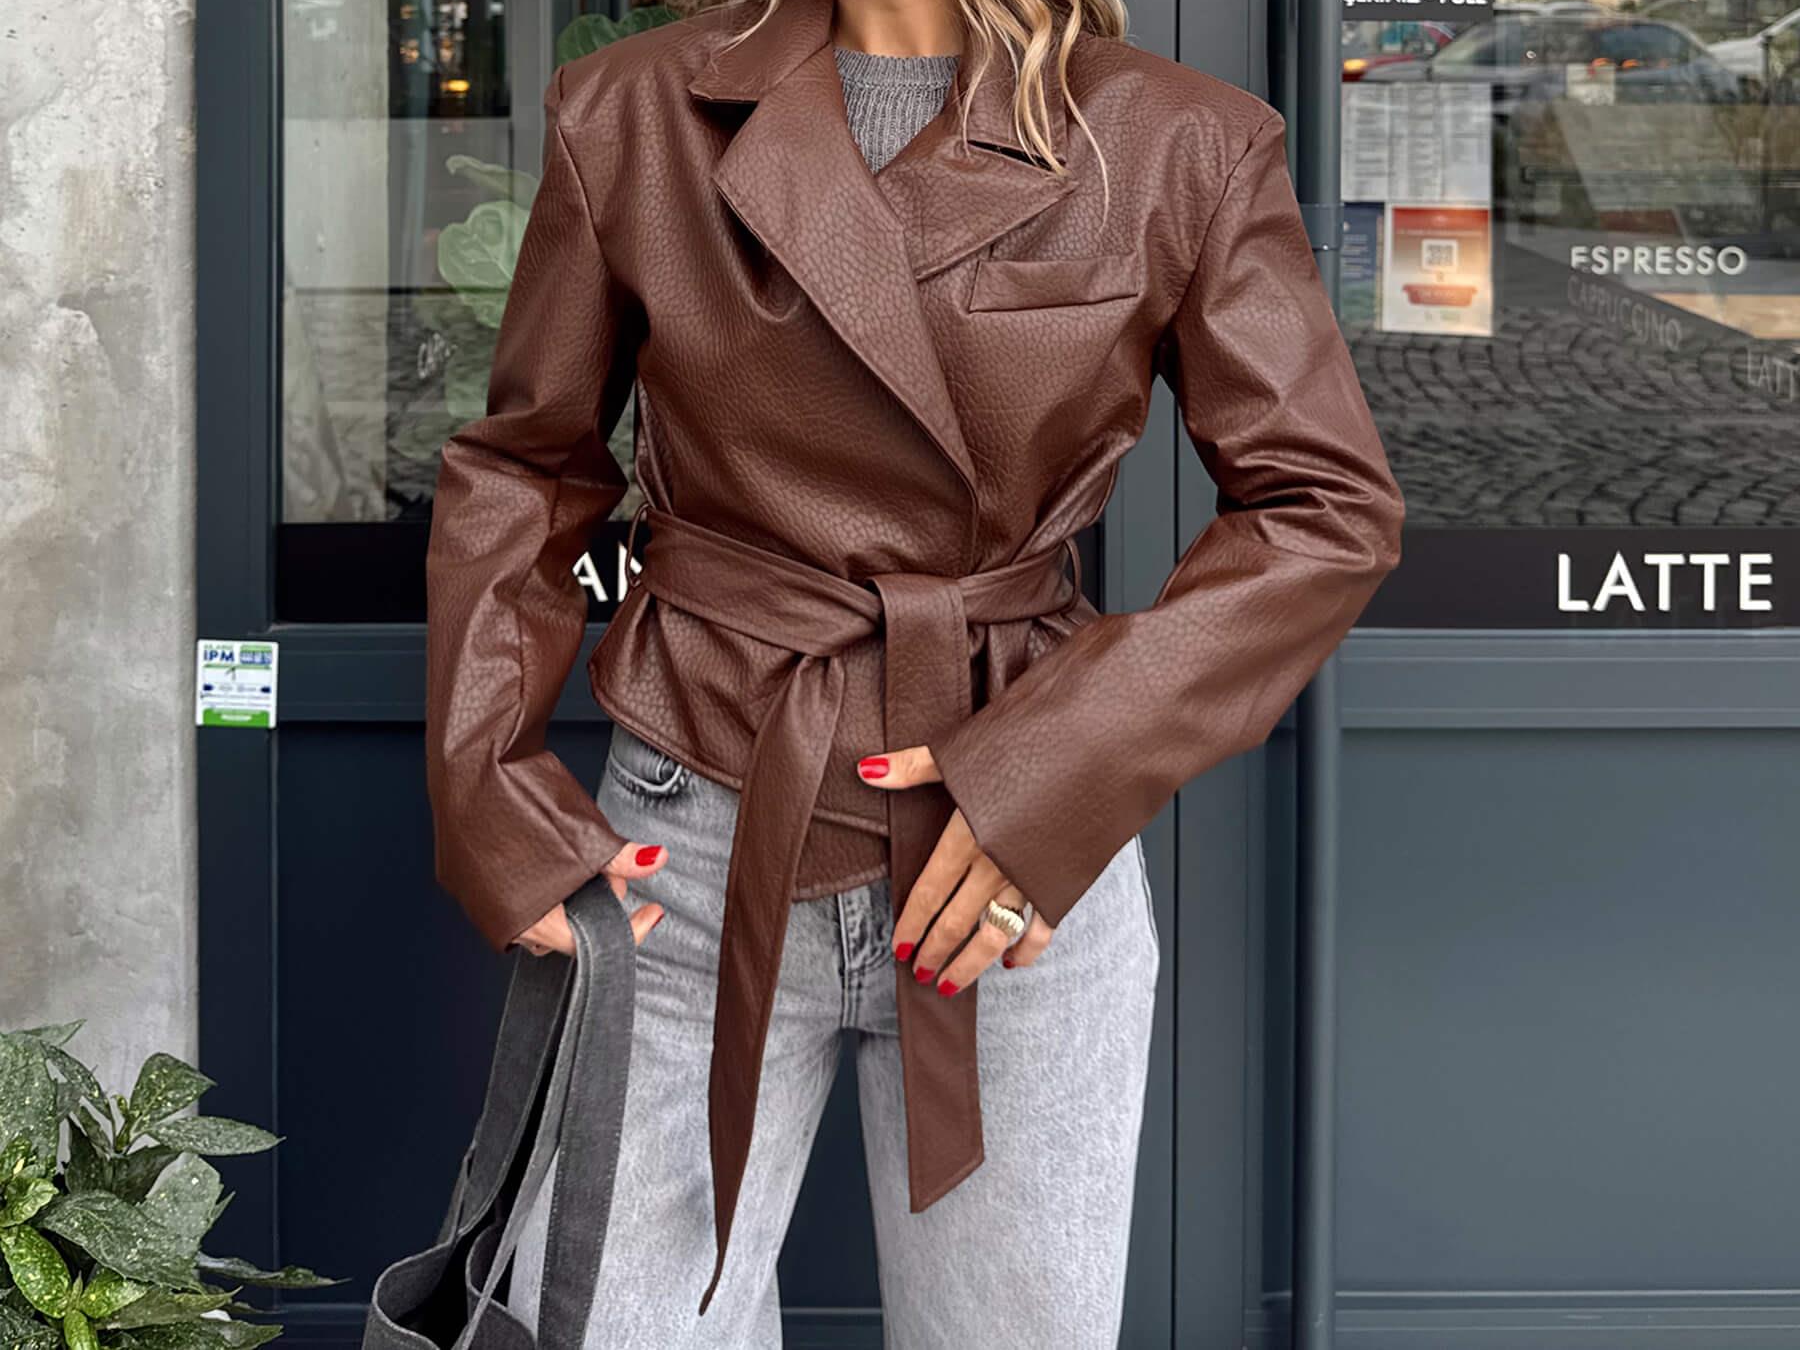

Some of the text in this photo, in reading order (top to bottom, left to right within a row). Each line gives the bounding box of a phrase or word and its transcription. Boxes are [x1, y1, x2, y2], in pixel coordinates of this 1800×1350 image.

[1570, 245, 1747, 276] ESPRESSO
[1558, 549, 1774, 613] LATTE
[203, 649, 236, 663] IPM
